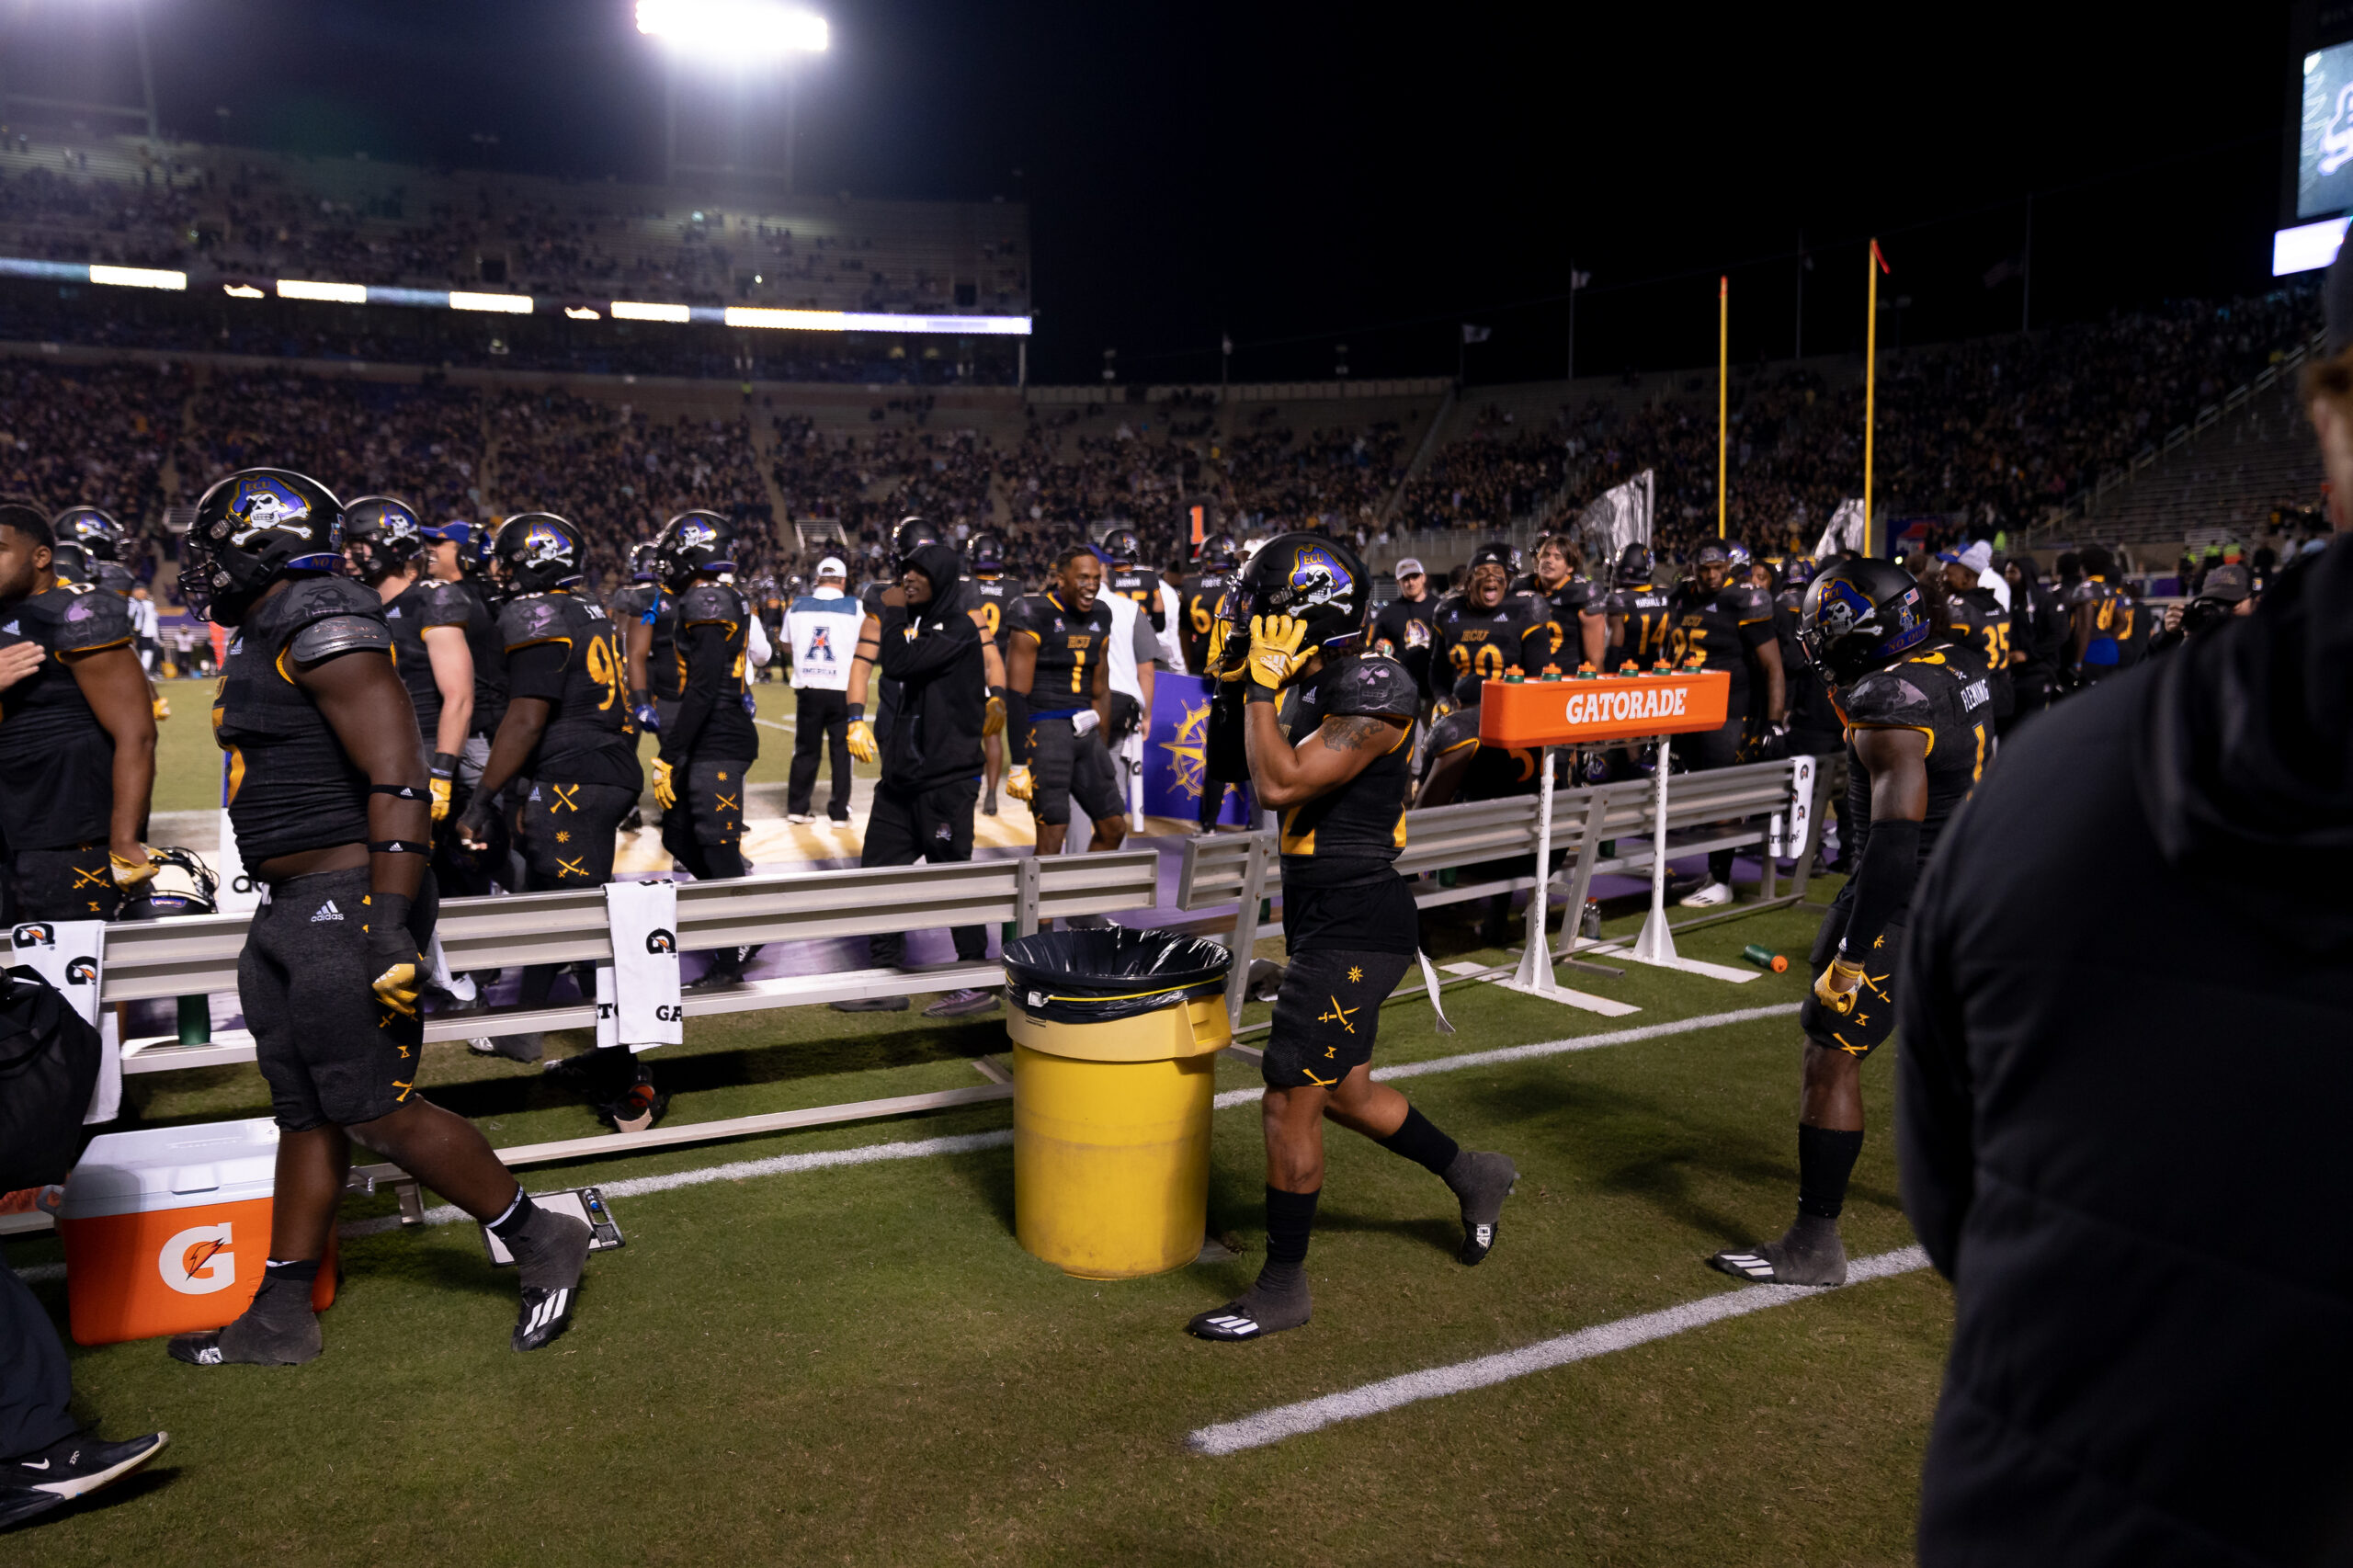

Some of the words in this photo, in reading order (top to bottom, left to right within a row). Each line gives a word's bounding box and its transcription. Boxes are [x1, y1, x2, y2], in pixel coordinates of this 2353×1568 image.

[245, 481, 270, 492] ECU
[1303, 552, 1324, 565] ECU
[1824, 586, 1844, 602] ECU
[1461, 631, 1489, 642] ECU
[1639, 612, 1670, 654] 14
[1671, 628, 1709, 668] 95
[1982, 621, 2010, 669] 35
[1072, 650, 1086, 693] 1
[1449, 643, 1504, 683] 90
[1565, 687, 1688, 724] GATORADE
[1961, 678, 1989, 712] FLEMING
[311, 913, 345, 922] adidas
[159, 1221, 235, 1294] G
